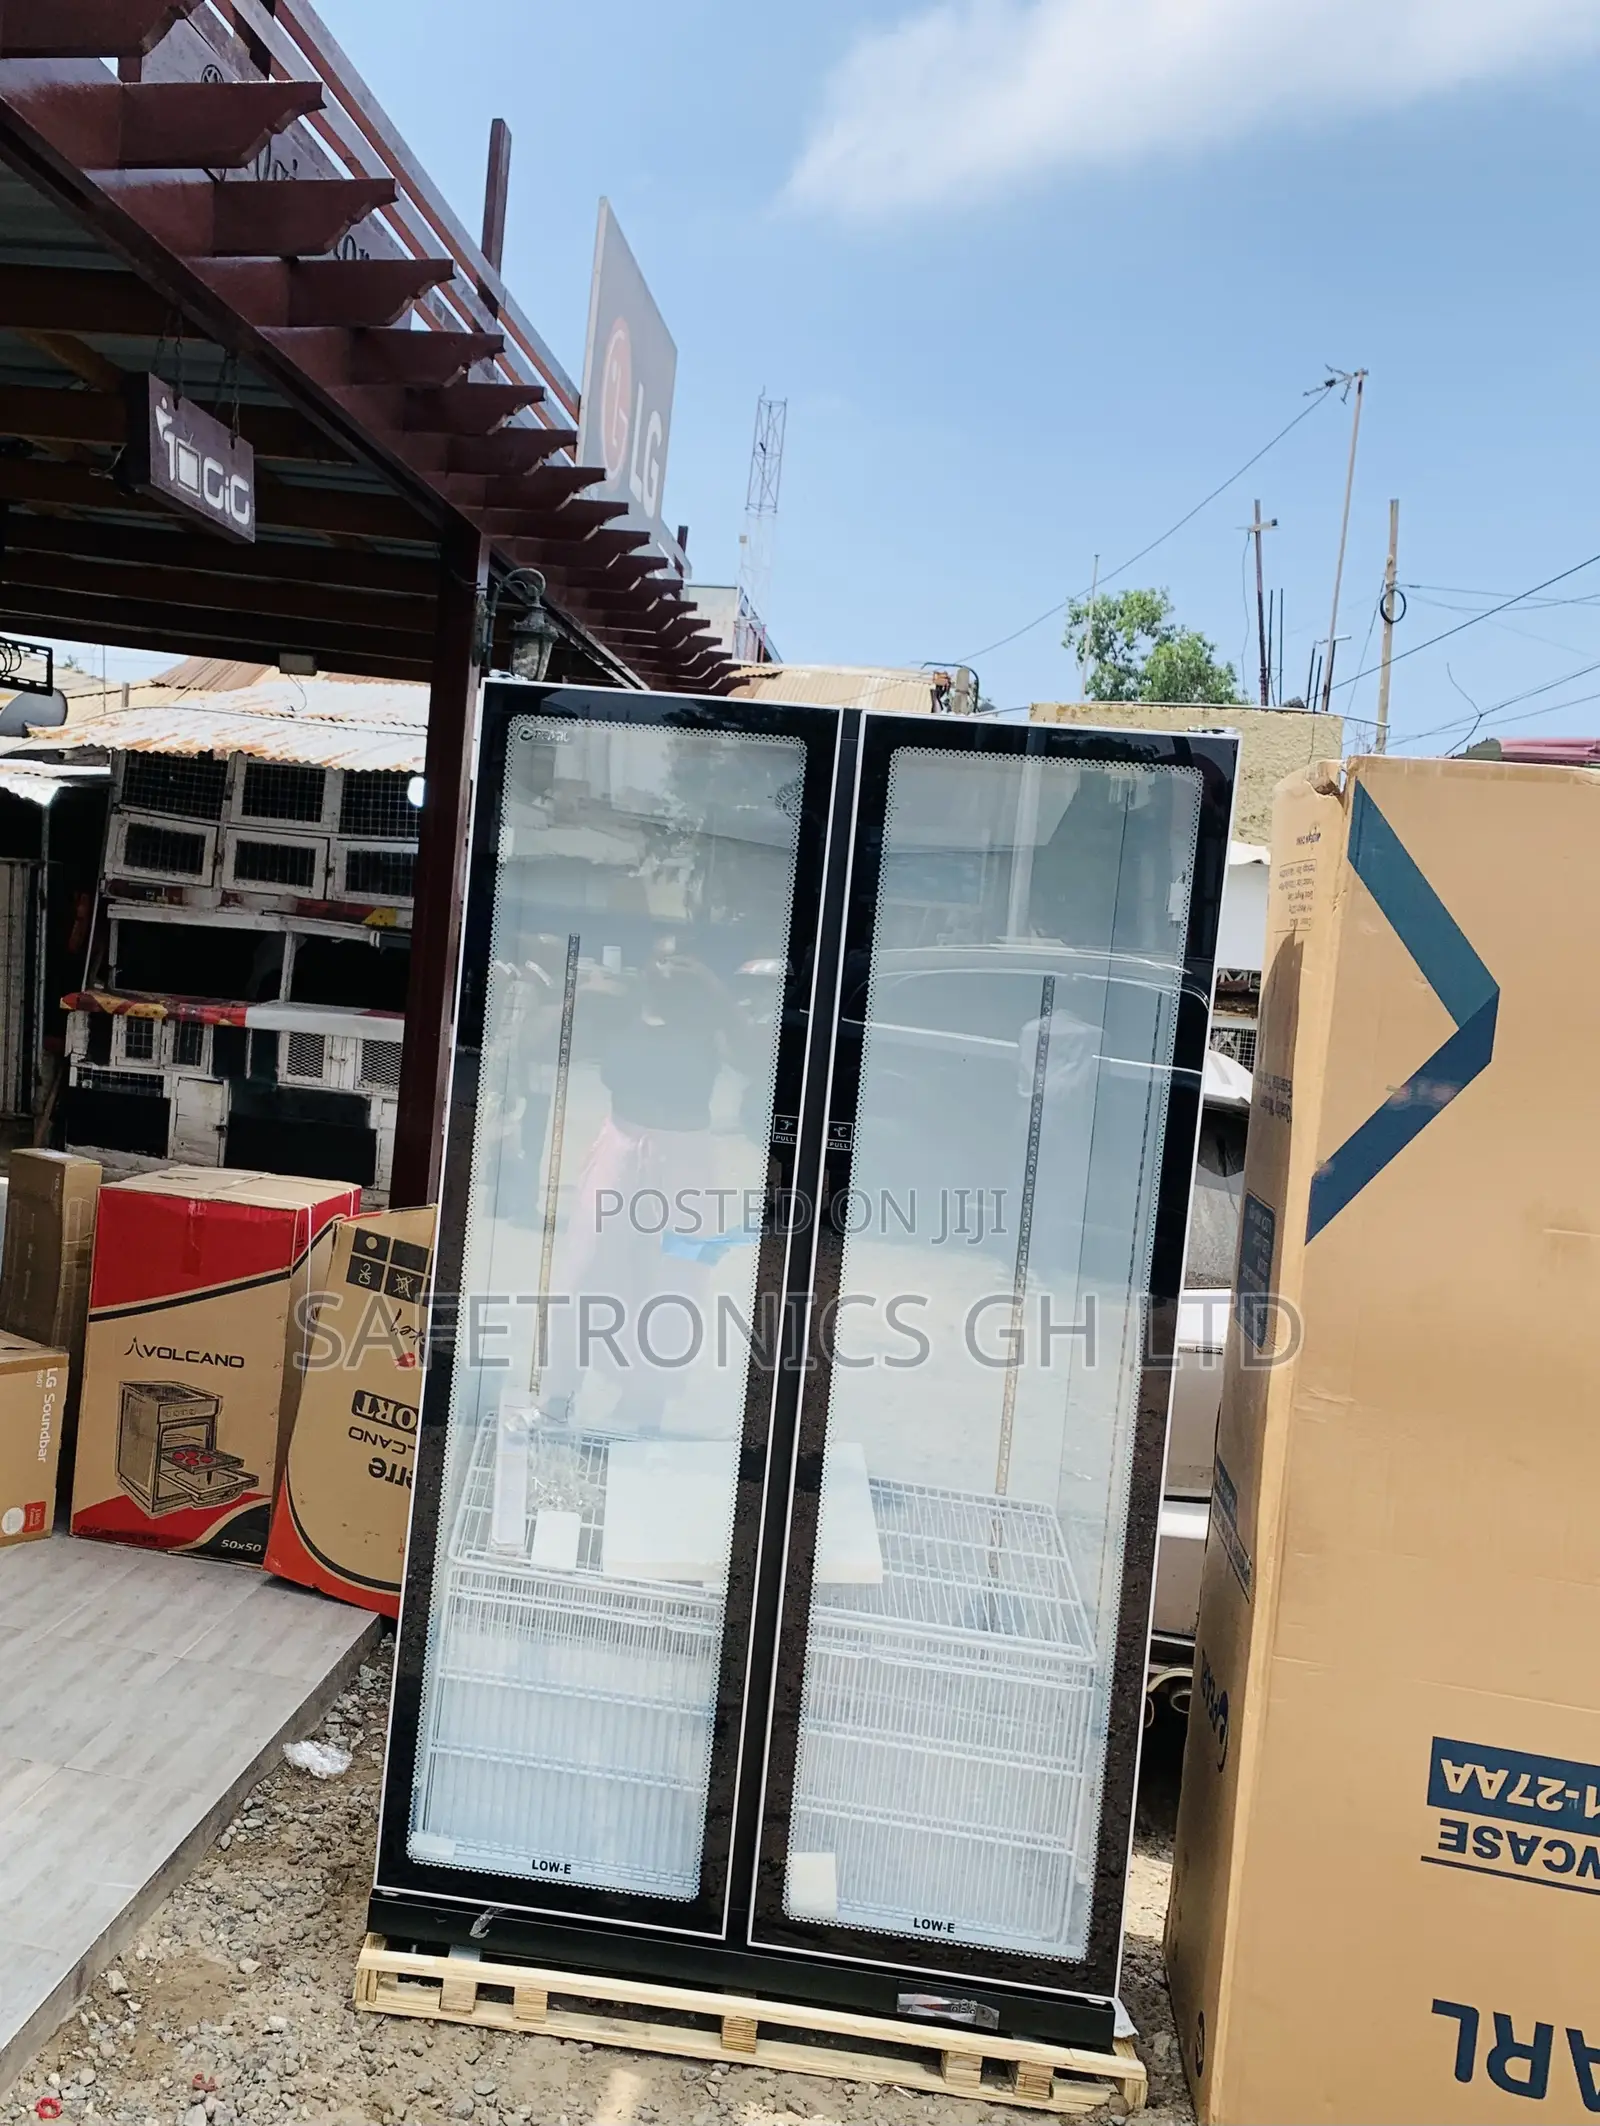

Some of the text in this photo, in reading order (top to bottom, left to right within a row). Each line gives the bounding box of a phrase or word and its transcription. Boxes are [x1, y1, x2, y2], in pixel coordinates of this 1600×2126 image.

[629, 380, 662, 519] LG
[775, 1134, 795, 1143] PULL
[828, 1140, 849, 1149] PULL
[142, 1344, 245, 1369] VOLCANO
[37, 1366, 59, 1464] LG Soundbar
[220, 1538, 262, 1553] 50x50
[531, 1859, 572, 1875] LOW-E
[913, 1916, 956, 1934] LOW-E
